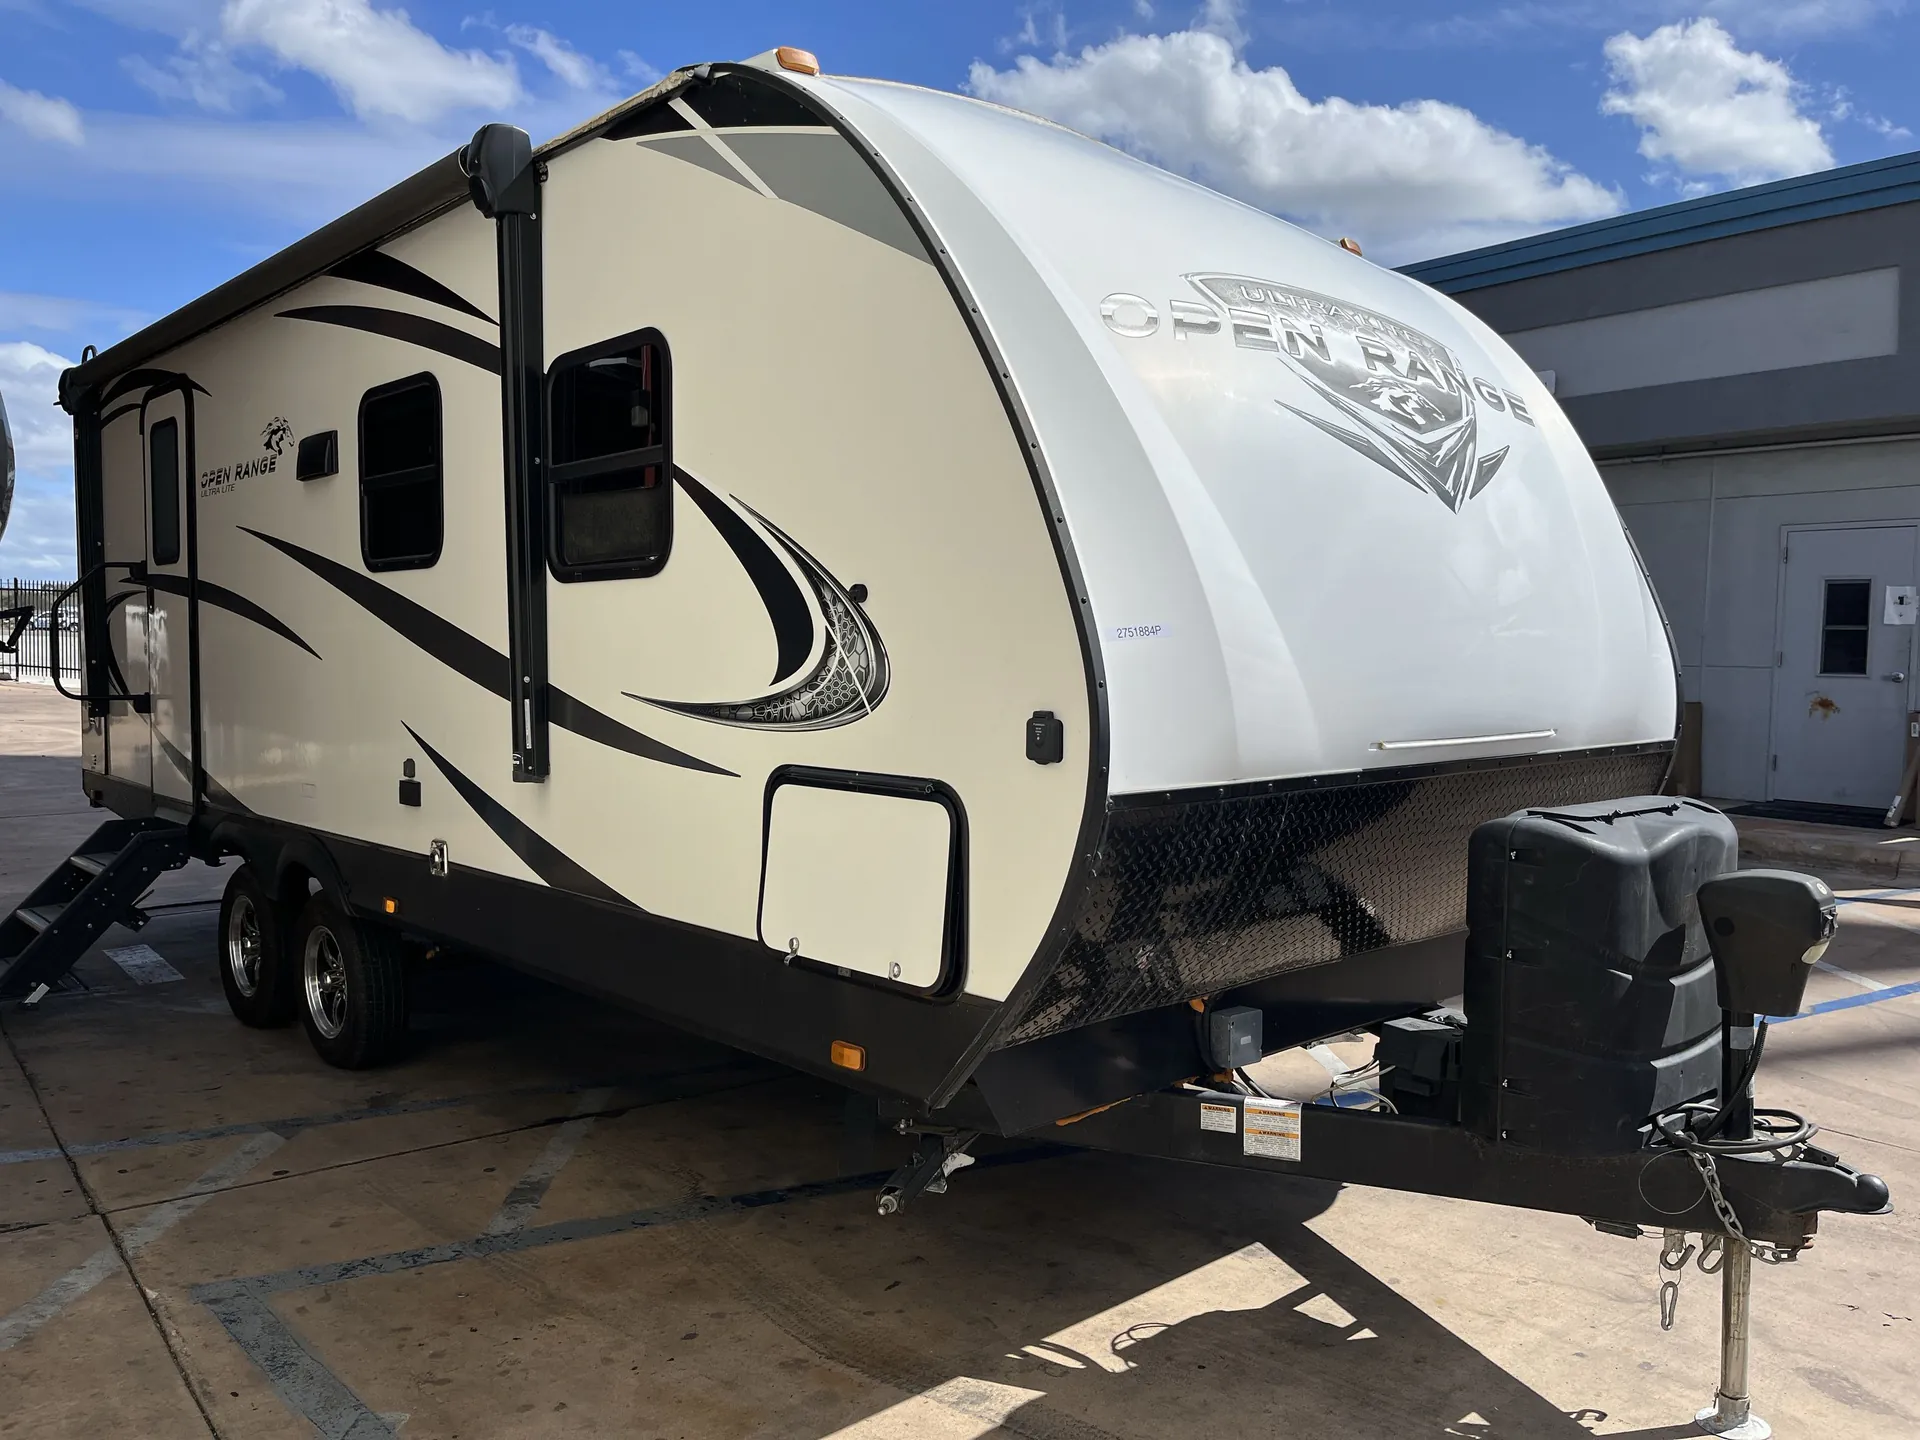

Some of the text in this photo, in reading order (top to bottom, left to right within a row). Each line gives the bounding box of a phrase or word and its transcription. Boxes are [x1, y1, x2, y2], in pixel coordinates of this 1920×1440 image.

[1099, 292, 1535, 427] OPEN RANGE
[201, 453, 278, 488] OPEN RANGE
[200, 483, 236, 498] ULTRA LITE
[1116, 625, 1161, 638] 2751884P
